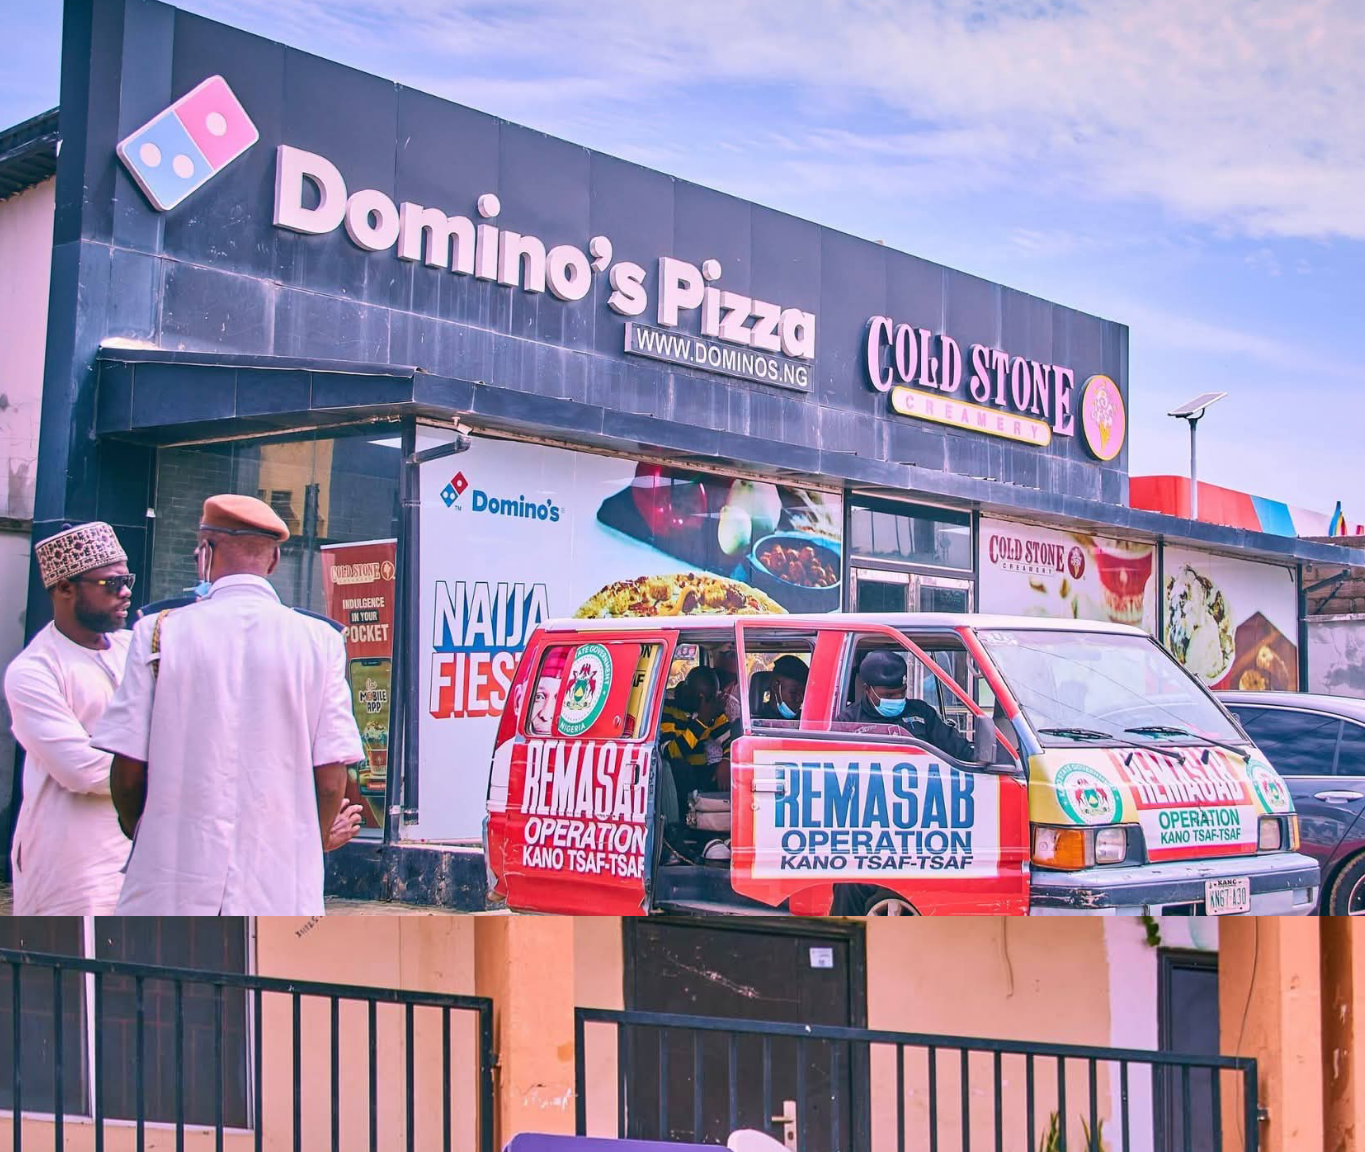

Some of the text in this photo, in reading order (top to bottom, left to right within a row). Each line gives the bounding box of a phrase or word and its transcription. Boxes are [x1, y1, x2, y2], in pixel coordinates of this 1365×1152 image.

[273, 144, 816, 360] Domino's Pizza
[636, 327, 808, 387] WWW.DOMINOS.NG
[866, 315, 1075, 437] COLD STONE
[905, 394, 1040, 439] CREAMERY
[472, 489, 560, 522] Domino's
[988, 534, 1065, 573] COLD STONE
[342, 597, 385, 610] INDULGENCE
[351, 611, 378, 622] IN YOUR
[344, 624, 389, 644] POCKET
[429, 652, 520, 720] FIES
[774, 761, 975, 830] REMASAB
[524, 817, 648, 854] OPERATION
[1158, 808, 1240, 830] OPERATION
[781, 830, 973, 855] OPERATION
[1160, 828, 1241, 845] KANO TSAF-TSAF
[522, 845, 564, 870] KANO
[780, 855, 974, 870] KANO TSAF-TSAF
